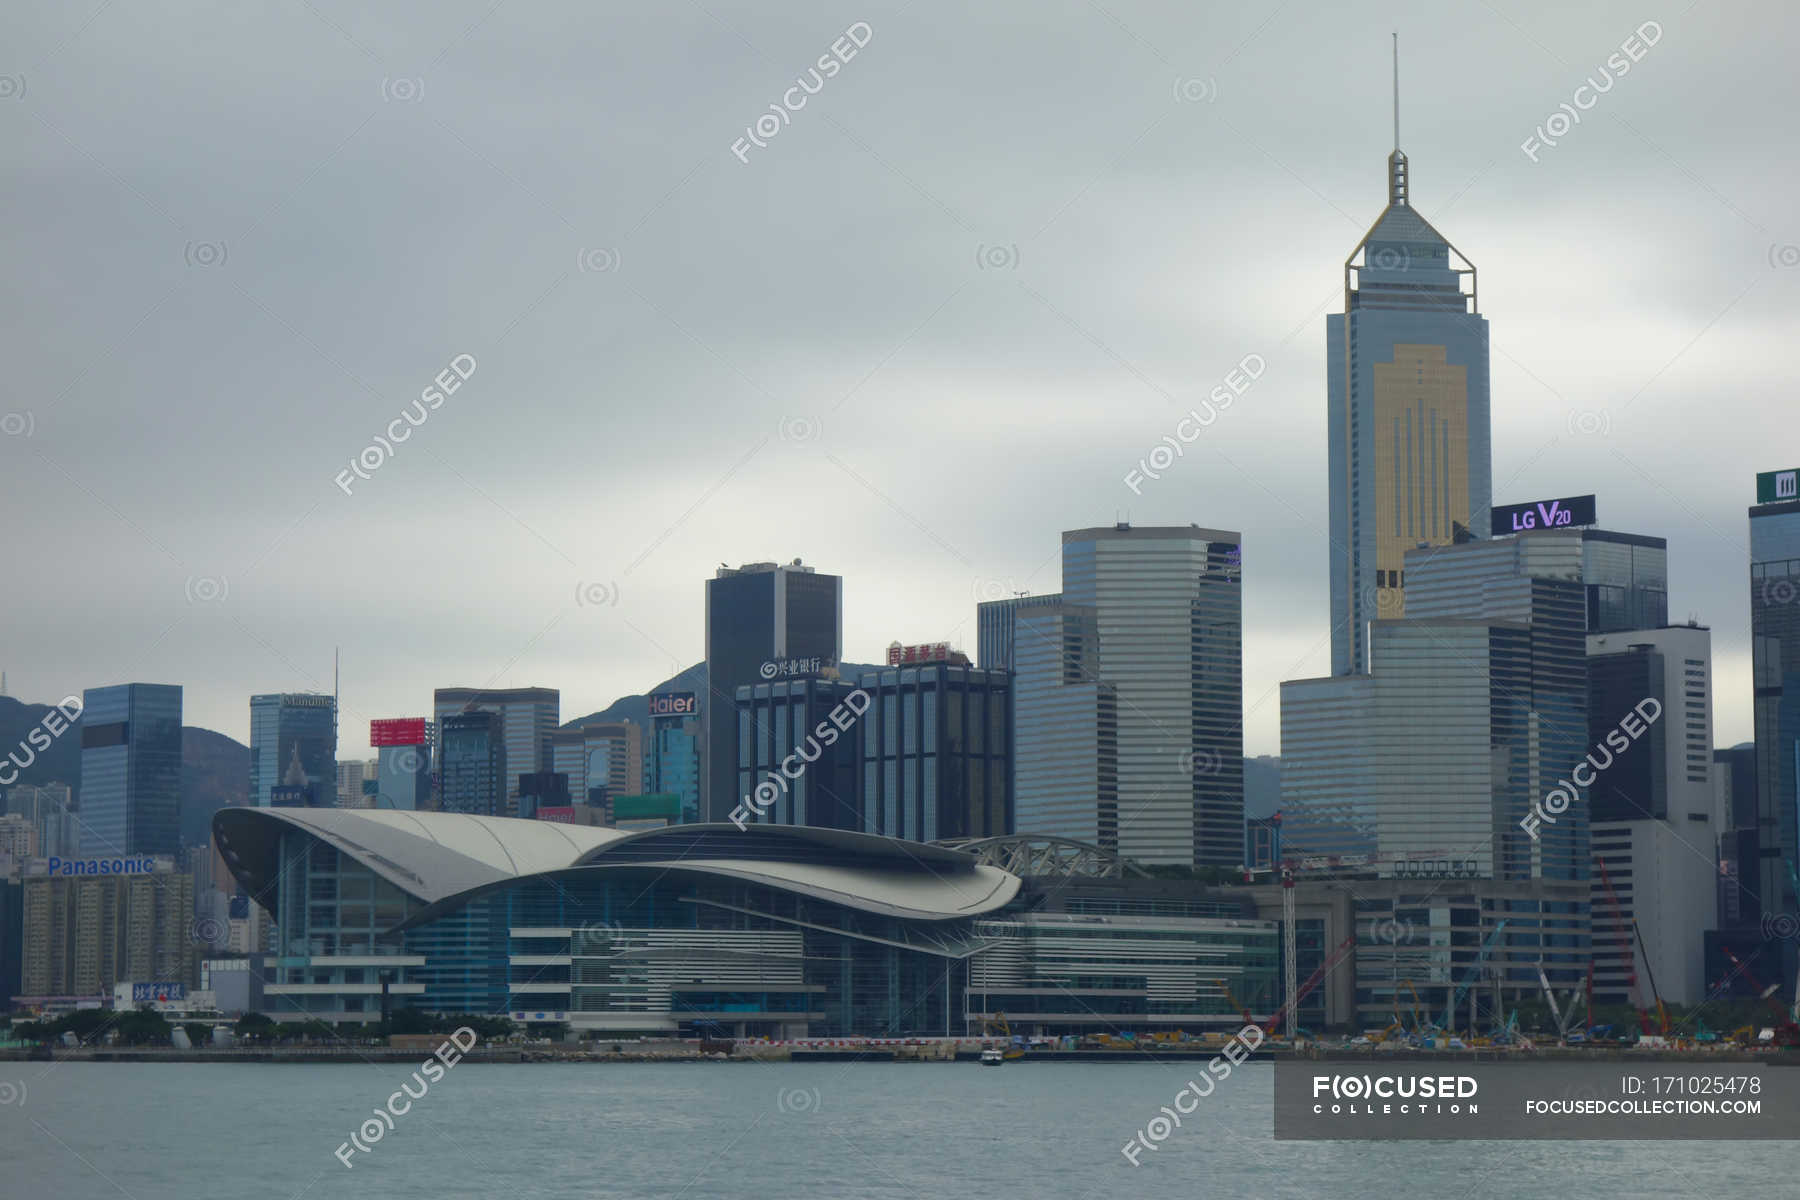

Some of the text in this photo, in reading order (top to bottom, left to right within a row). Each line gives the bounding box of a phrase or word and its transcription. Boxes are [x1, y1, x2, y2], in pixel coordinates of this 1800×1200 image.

[1512, 501, 1571, 530] LG V20
[649, 693, 694, 713] Haier
[48, 856, 154, 876] Panasonic
